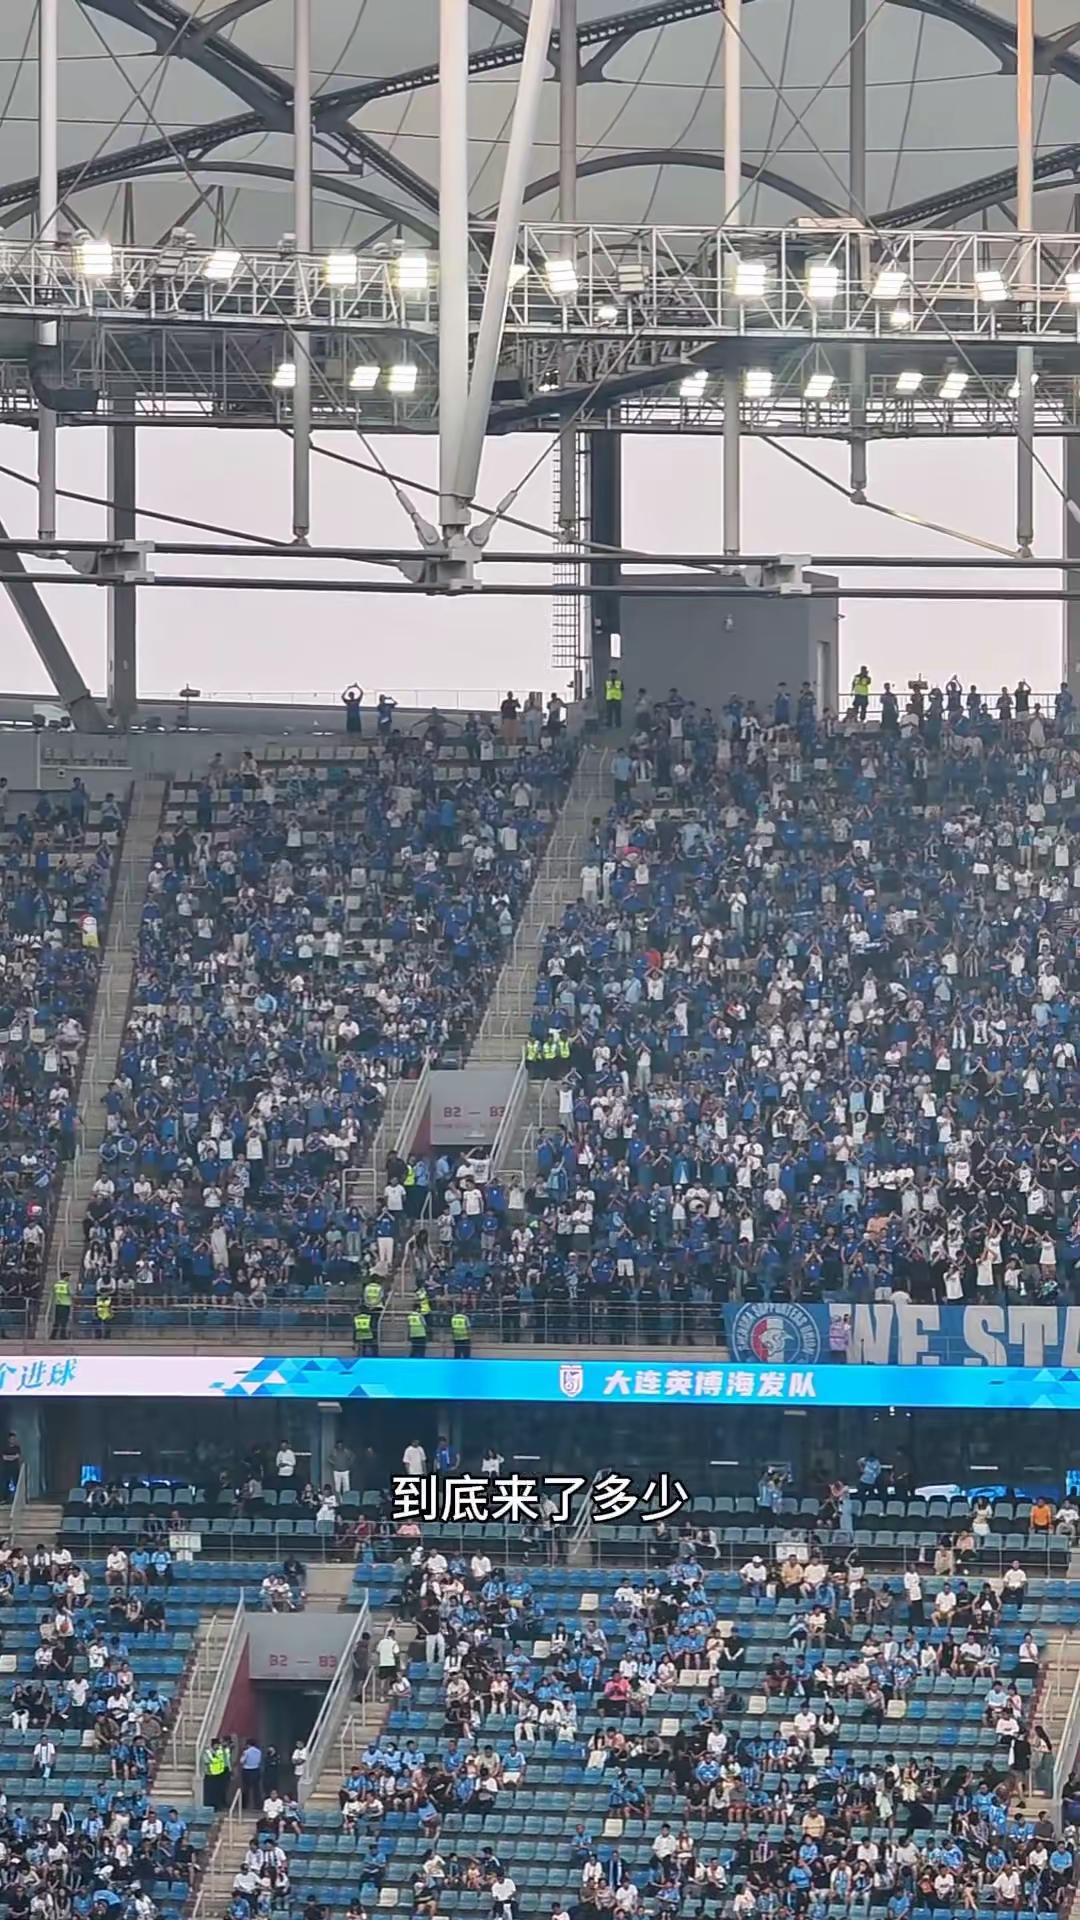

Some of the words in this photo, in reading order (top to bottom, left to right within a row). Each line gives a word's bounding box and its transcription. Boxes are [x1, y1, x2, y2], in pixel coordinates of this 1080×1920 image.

[443, 1106, 462, 1118] B2
[829, 1303, 940, 1366] WE
[602, 1369, 817, 1398] 大连英博海发队
[268, 1653, 289, 1667] B2
